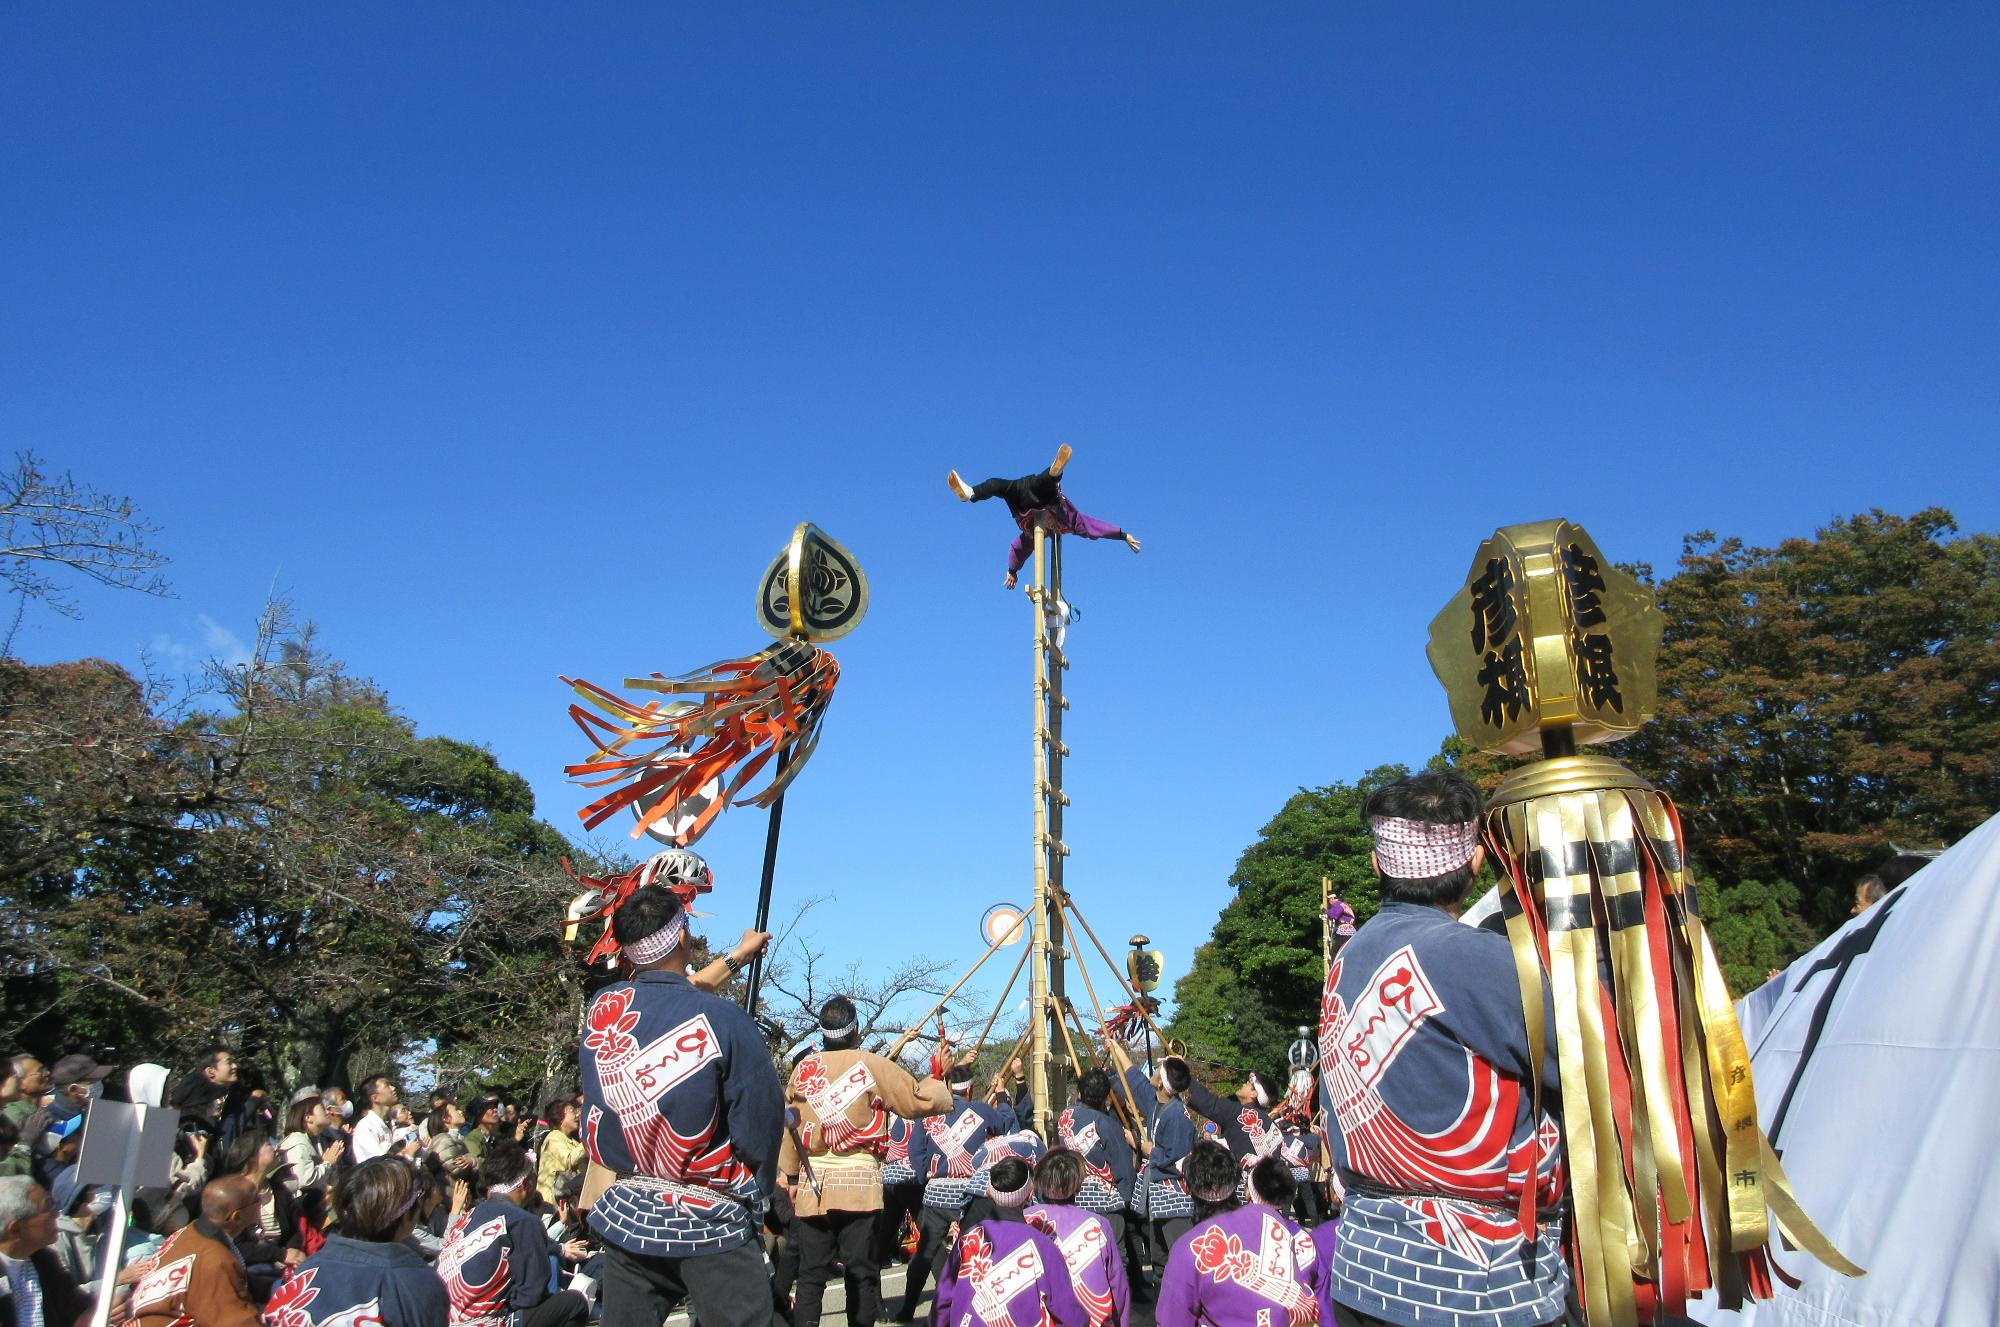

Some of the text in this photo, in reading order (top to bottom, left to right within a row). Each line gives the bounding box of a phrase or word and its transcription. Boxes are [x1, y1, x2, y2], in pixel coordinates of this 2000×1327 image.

[1470, 556, 1531, 729] 彦根
[1730, 1065, 1756, 1188] 彦根市
